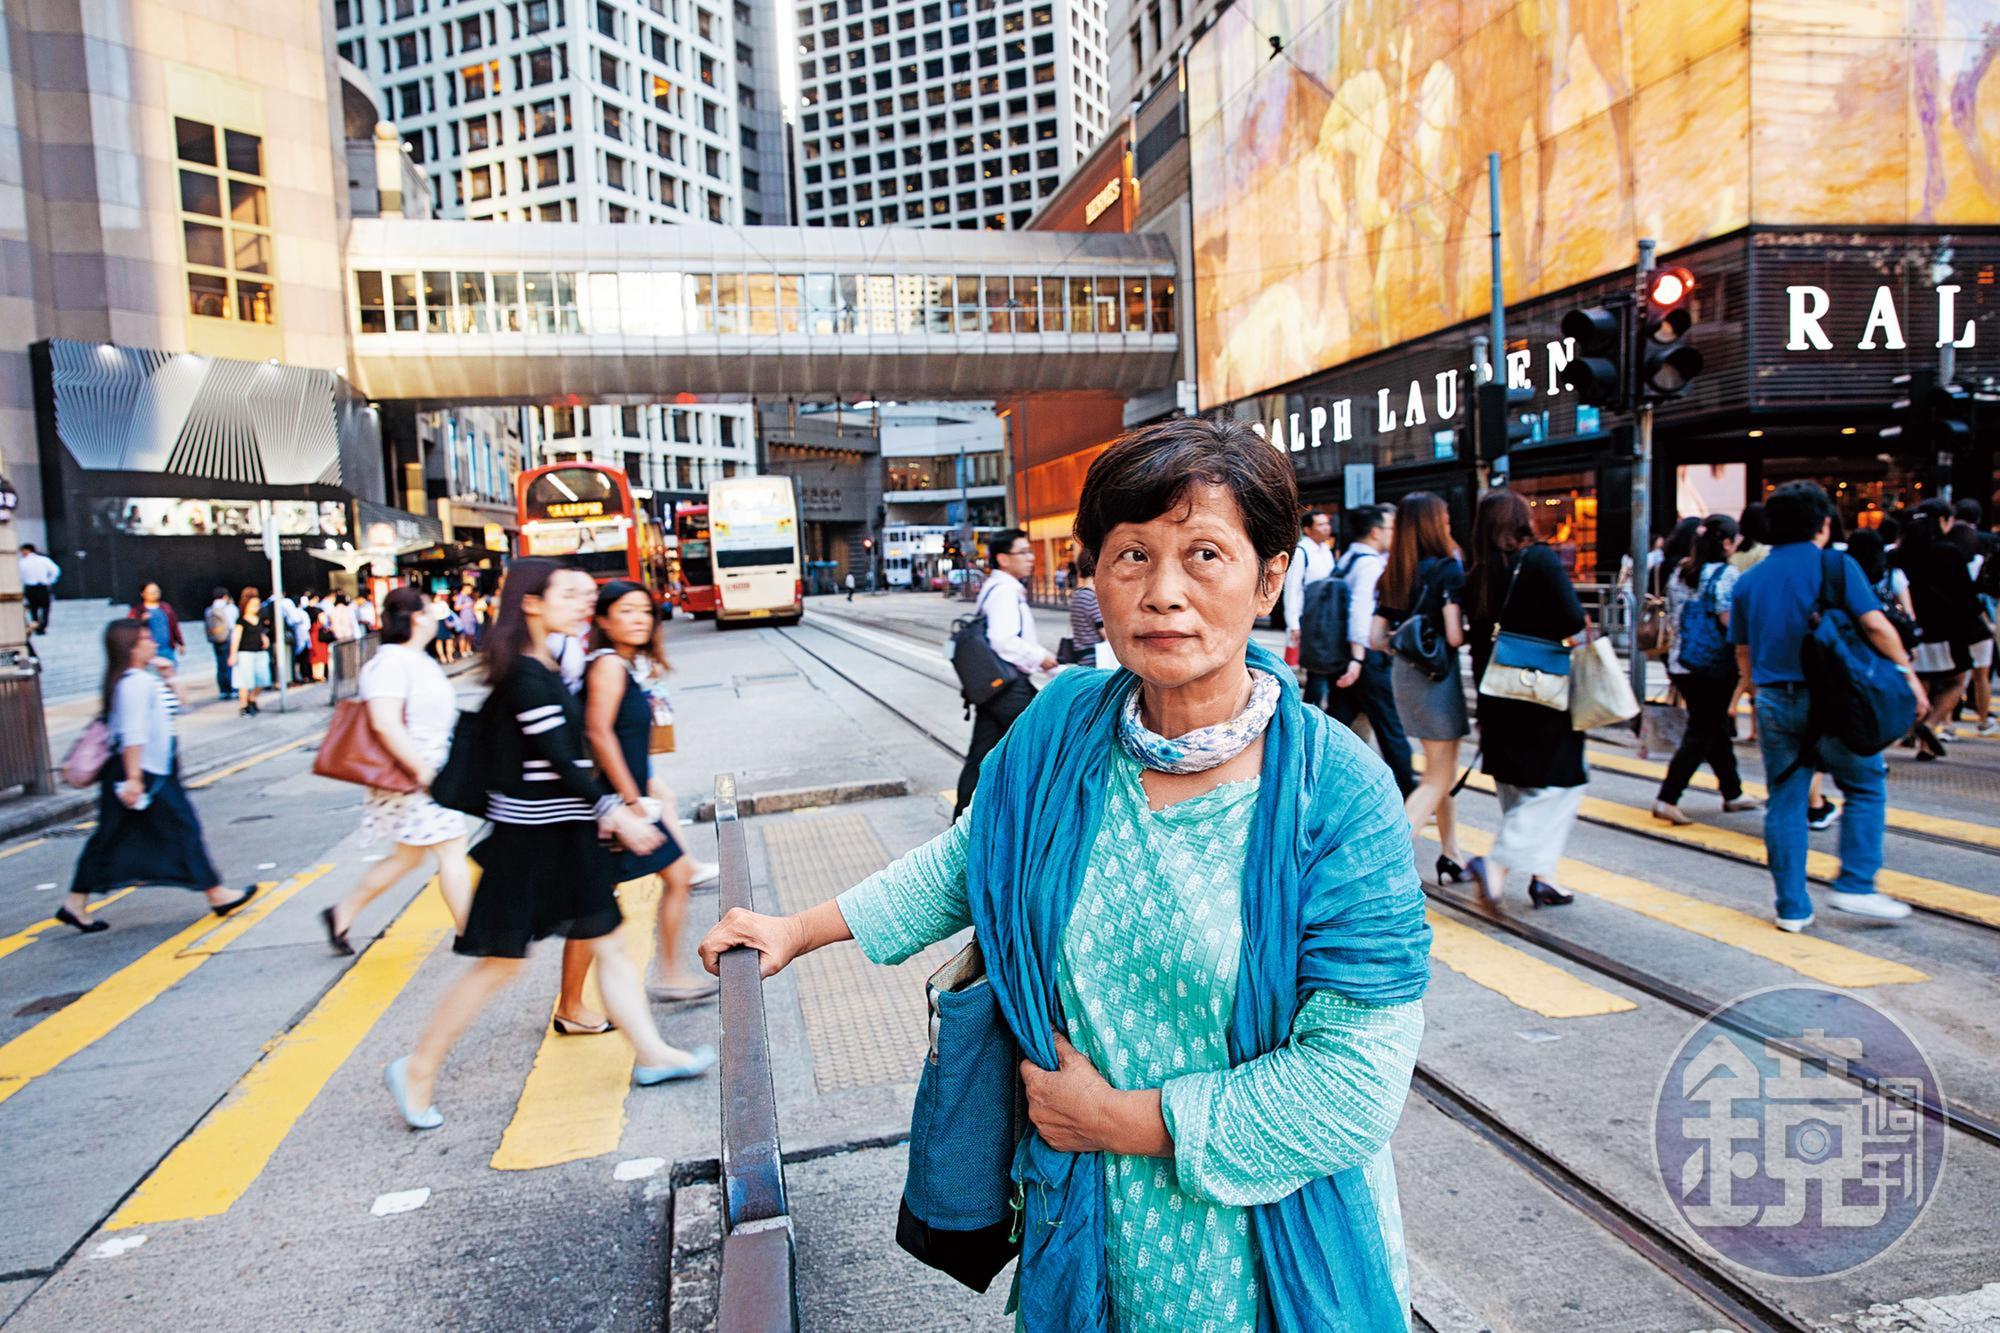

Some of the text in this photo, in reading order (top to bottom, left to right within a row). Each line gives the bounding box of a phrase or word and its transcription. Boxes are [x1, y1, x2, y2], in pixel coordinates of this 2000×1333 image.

[1786, 285, 1976, 351] RAL
[1252, 336, 1576, 454] ALPH LAUEN
